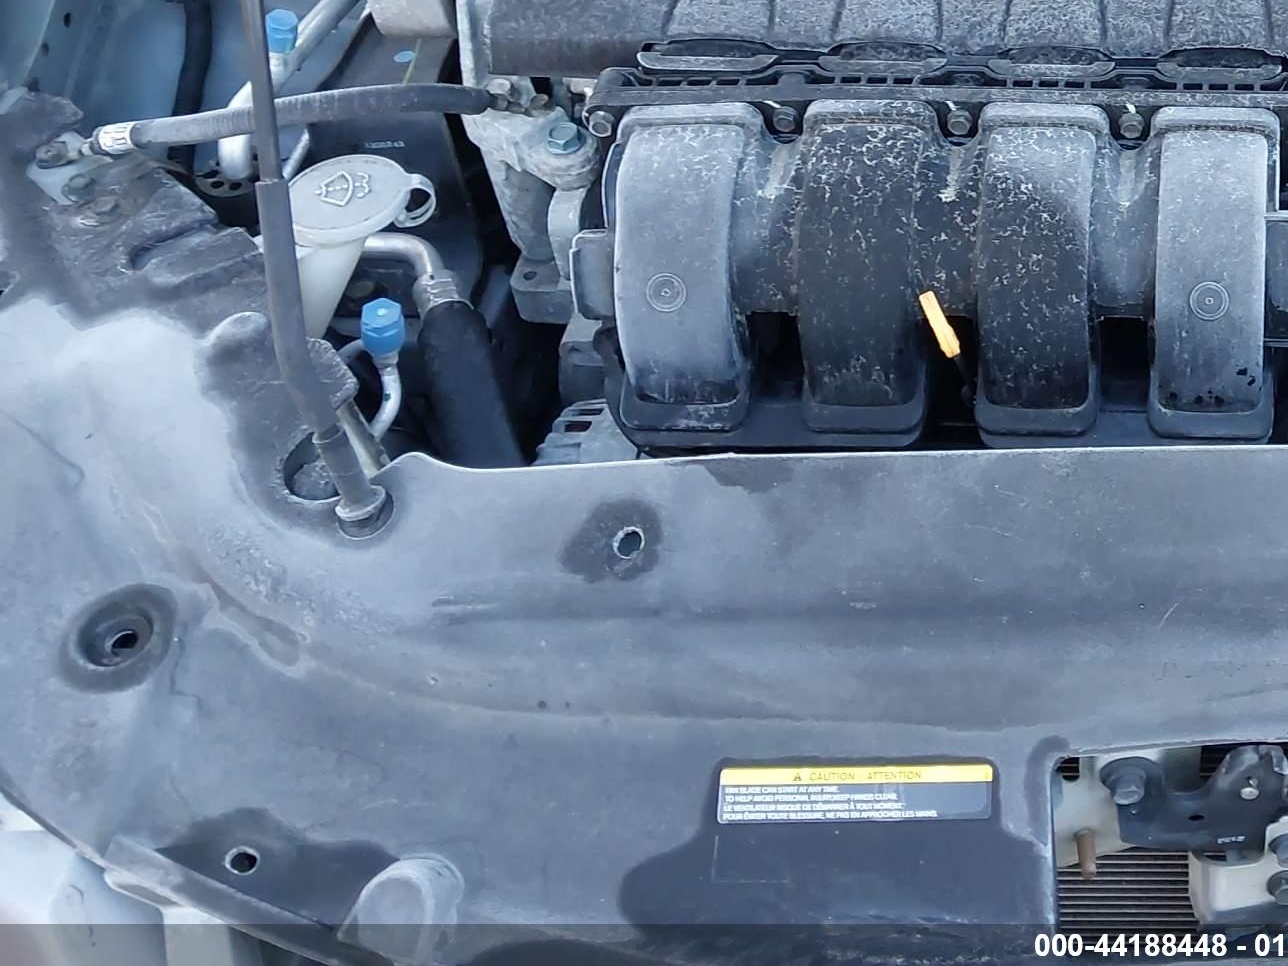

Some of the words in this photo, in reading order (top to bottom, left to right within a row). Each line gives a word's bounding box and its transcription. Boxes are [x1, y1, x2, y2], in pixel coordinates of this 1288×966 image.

[809, 772, 855, 781] CAUTION
[867, 771, 922, 780] ATTENTION
[761, 786, 777, 794] CAN
[725, 795, 734, 803] TO
